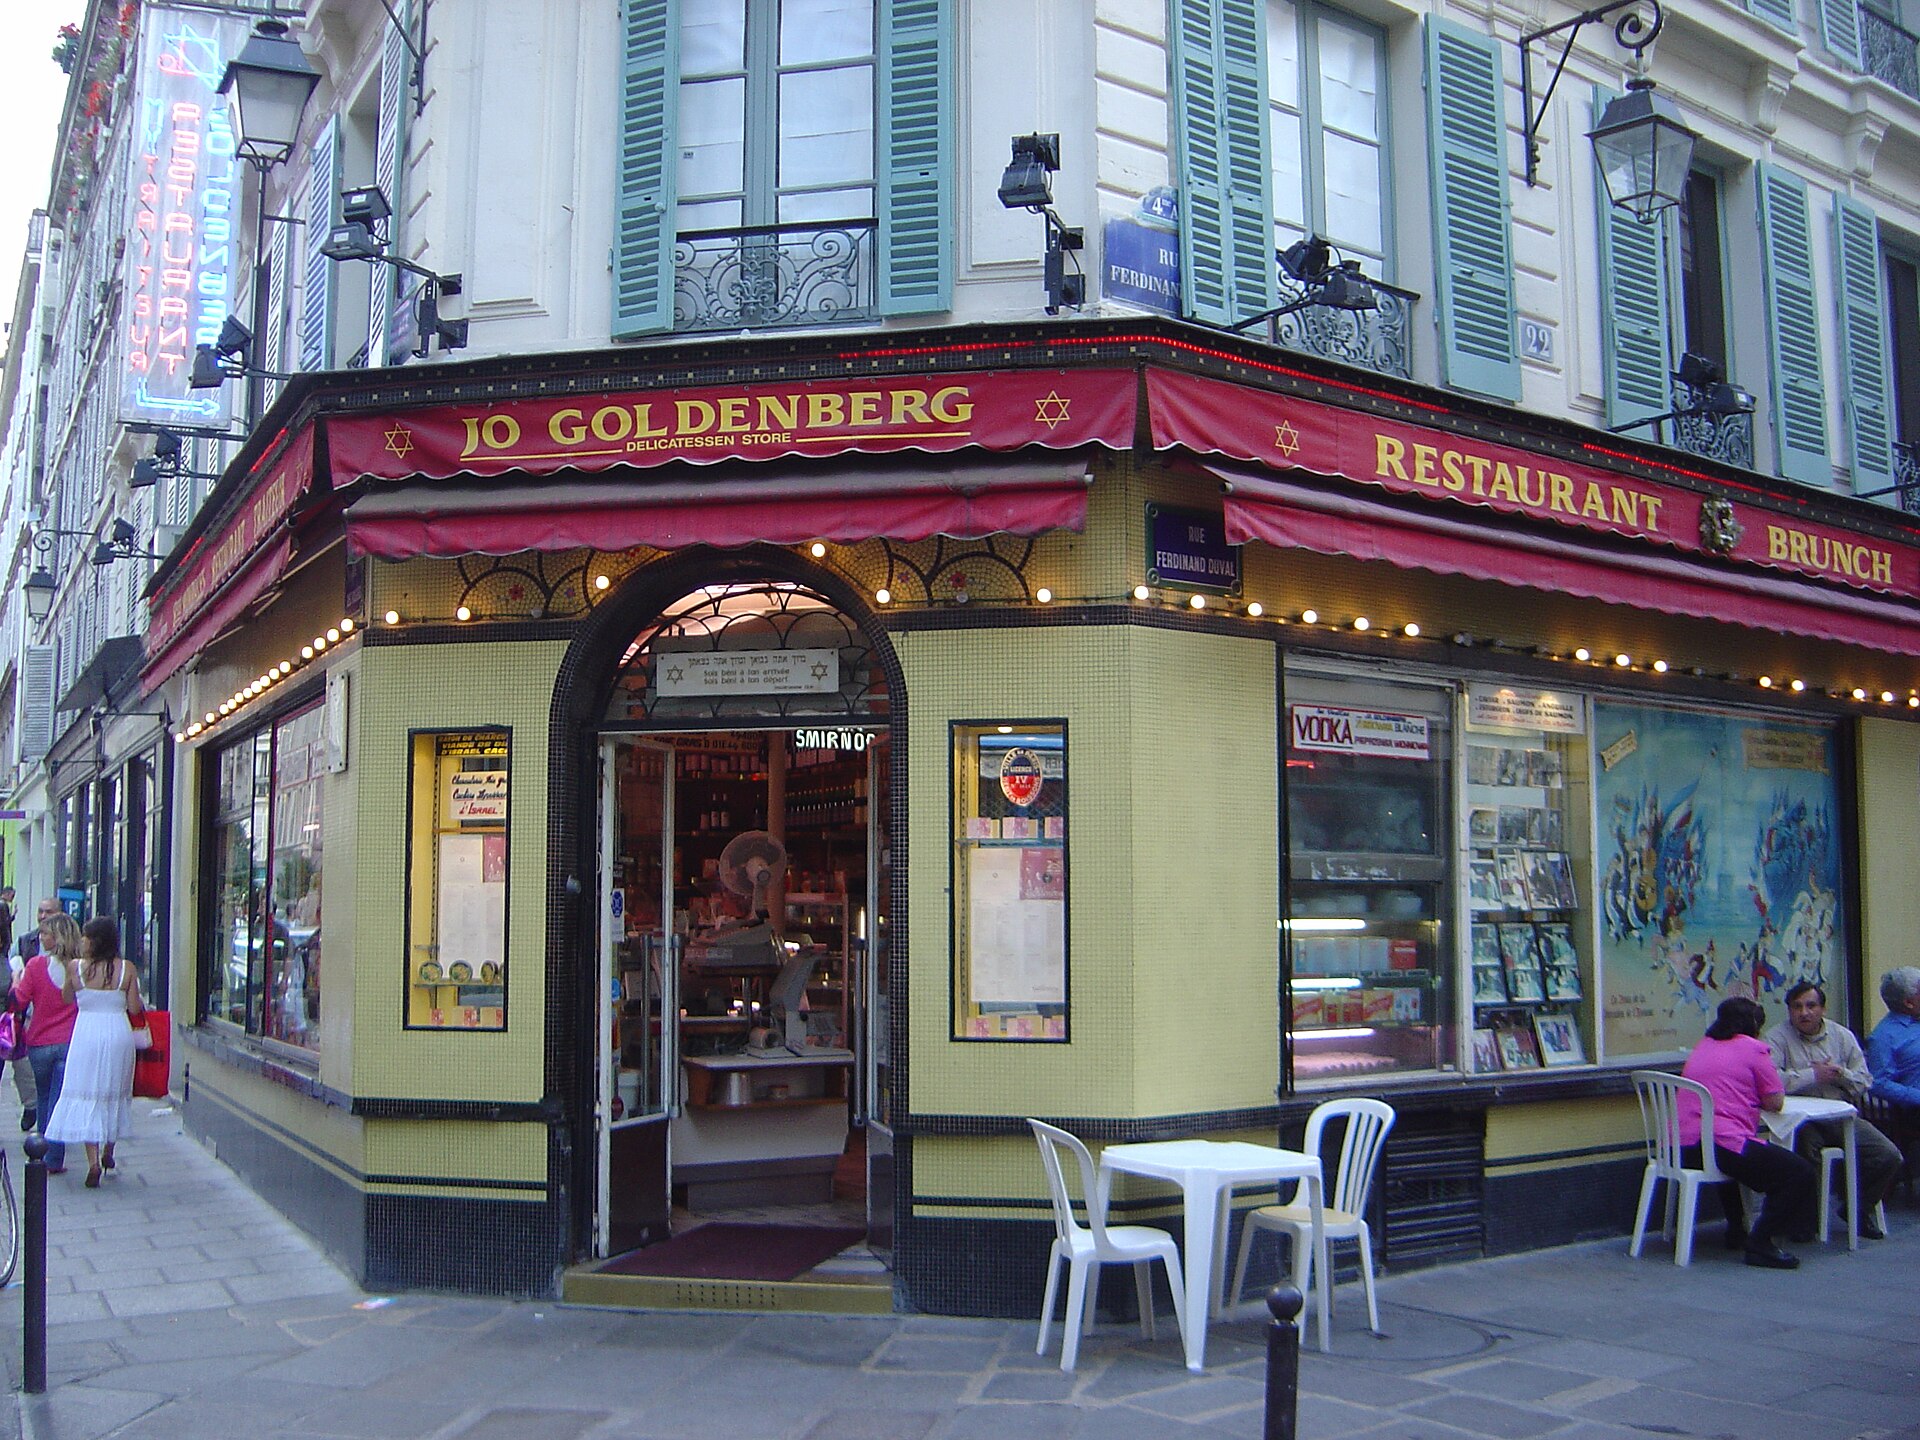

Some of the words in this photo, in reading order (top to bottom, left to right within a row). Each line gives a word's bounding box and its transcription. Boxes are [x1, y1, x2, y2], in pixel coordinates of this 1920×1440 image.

[1158, 247, 1179, 267] RU
[1111, 264, 1180, 299] FERDINAN
[1526, 324, 1551, 358] 22
[460, 414, 521, 457] JO
[548, 386, 975, 445] GOLDENBERG
[626, 435, 735, 452] DELICATESSEN
[741, 432, 792, 446] STORE
[1374, 434, 1663, 532] RESTAURANT
[1188, 526, 1205, 544] RUE
[1156, 550, 1206, 573] FERDINAND
[1208, 557, 1236, 577] DUVAL
[1767, 524, 1894, 584] BRUNCH
[1507, 698, 1535, 707] SAUMON
[1295, 713, 1354, 745] VODKA
[1394, 722, 1425, 736] BLANCHE
[1010, 765, 1032, 773] LICENCE
[1015, 775, 1029, 784] IV
[69, 900, 79, 915] P
